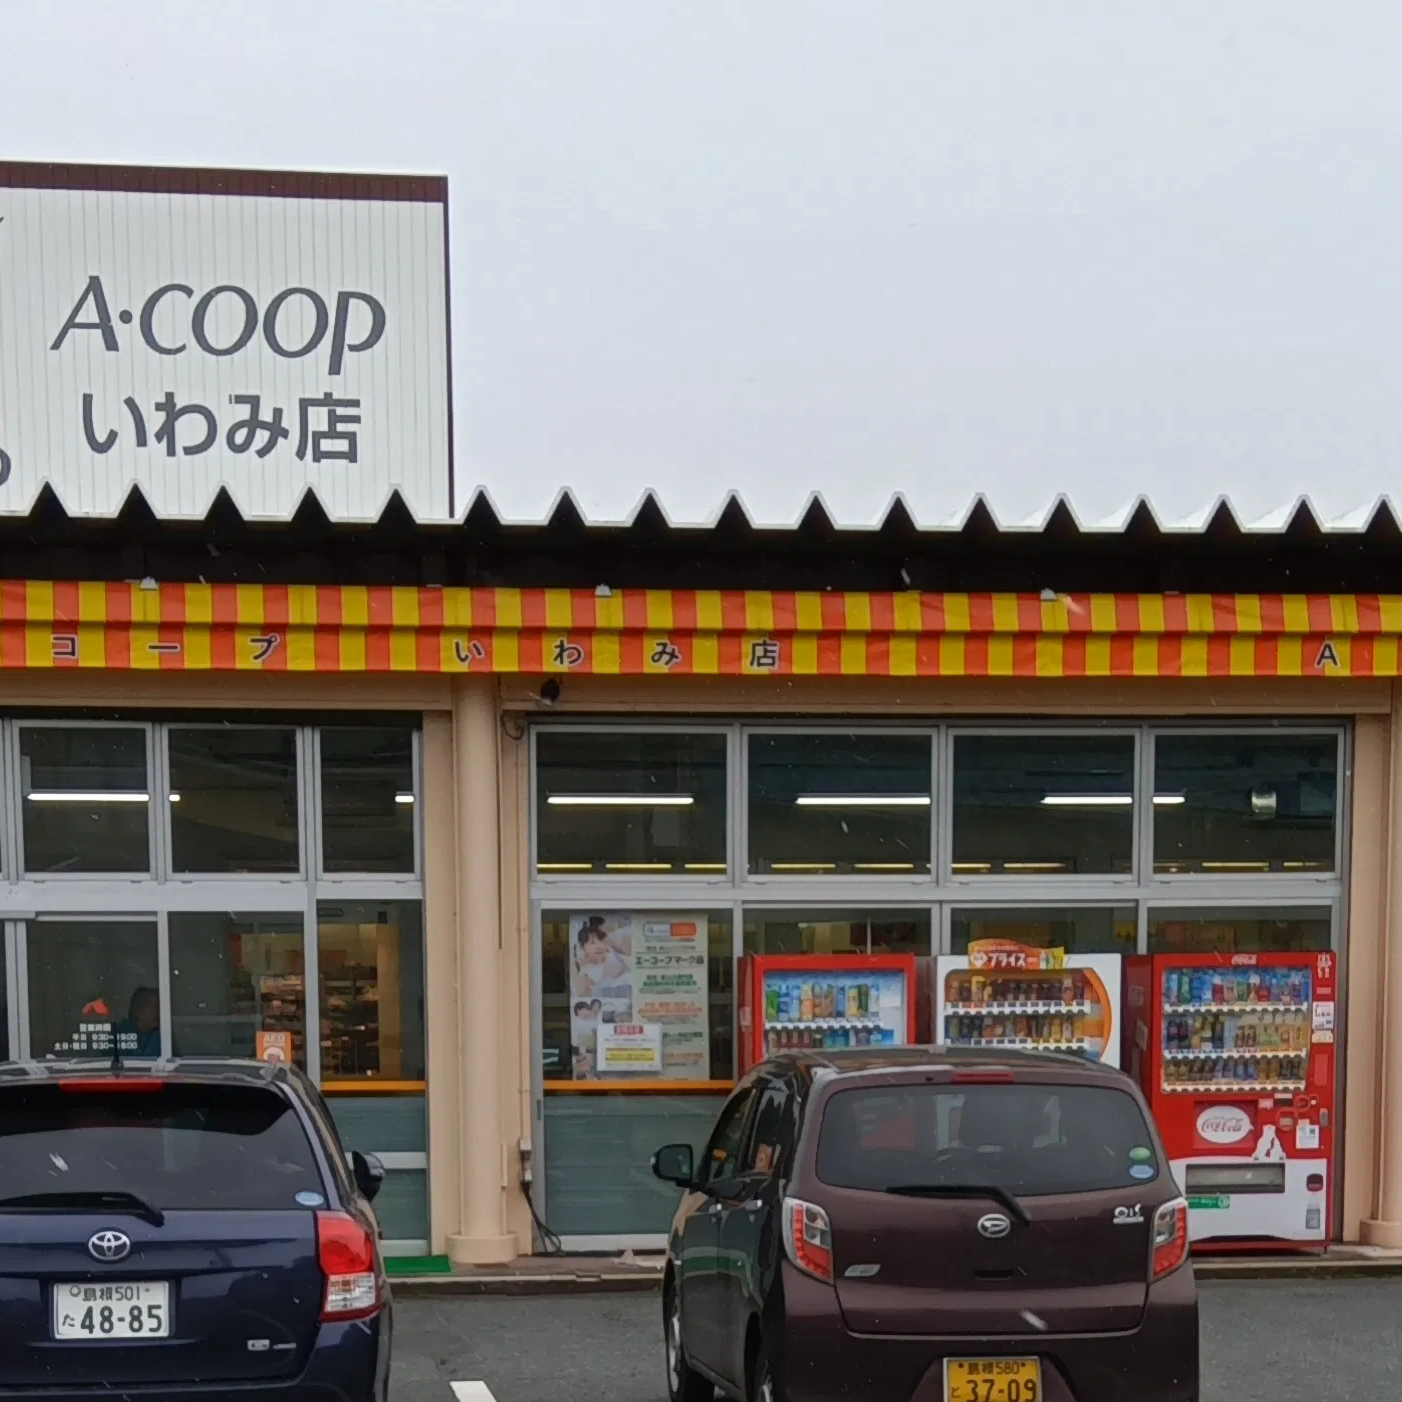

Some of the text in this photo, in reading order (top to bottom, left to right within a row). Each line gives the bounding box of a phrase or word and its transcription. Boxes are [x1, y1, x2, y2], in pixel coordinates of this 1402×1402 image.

[82, 391, 362, 464] いわみ店
[80, 1304, 162, 1334] 48-85
[966, 1379, 1037, 1402] 37-09
